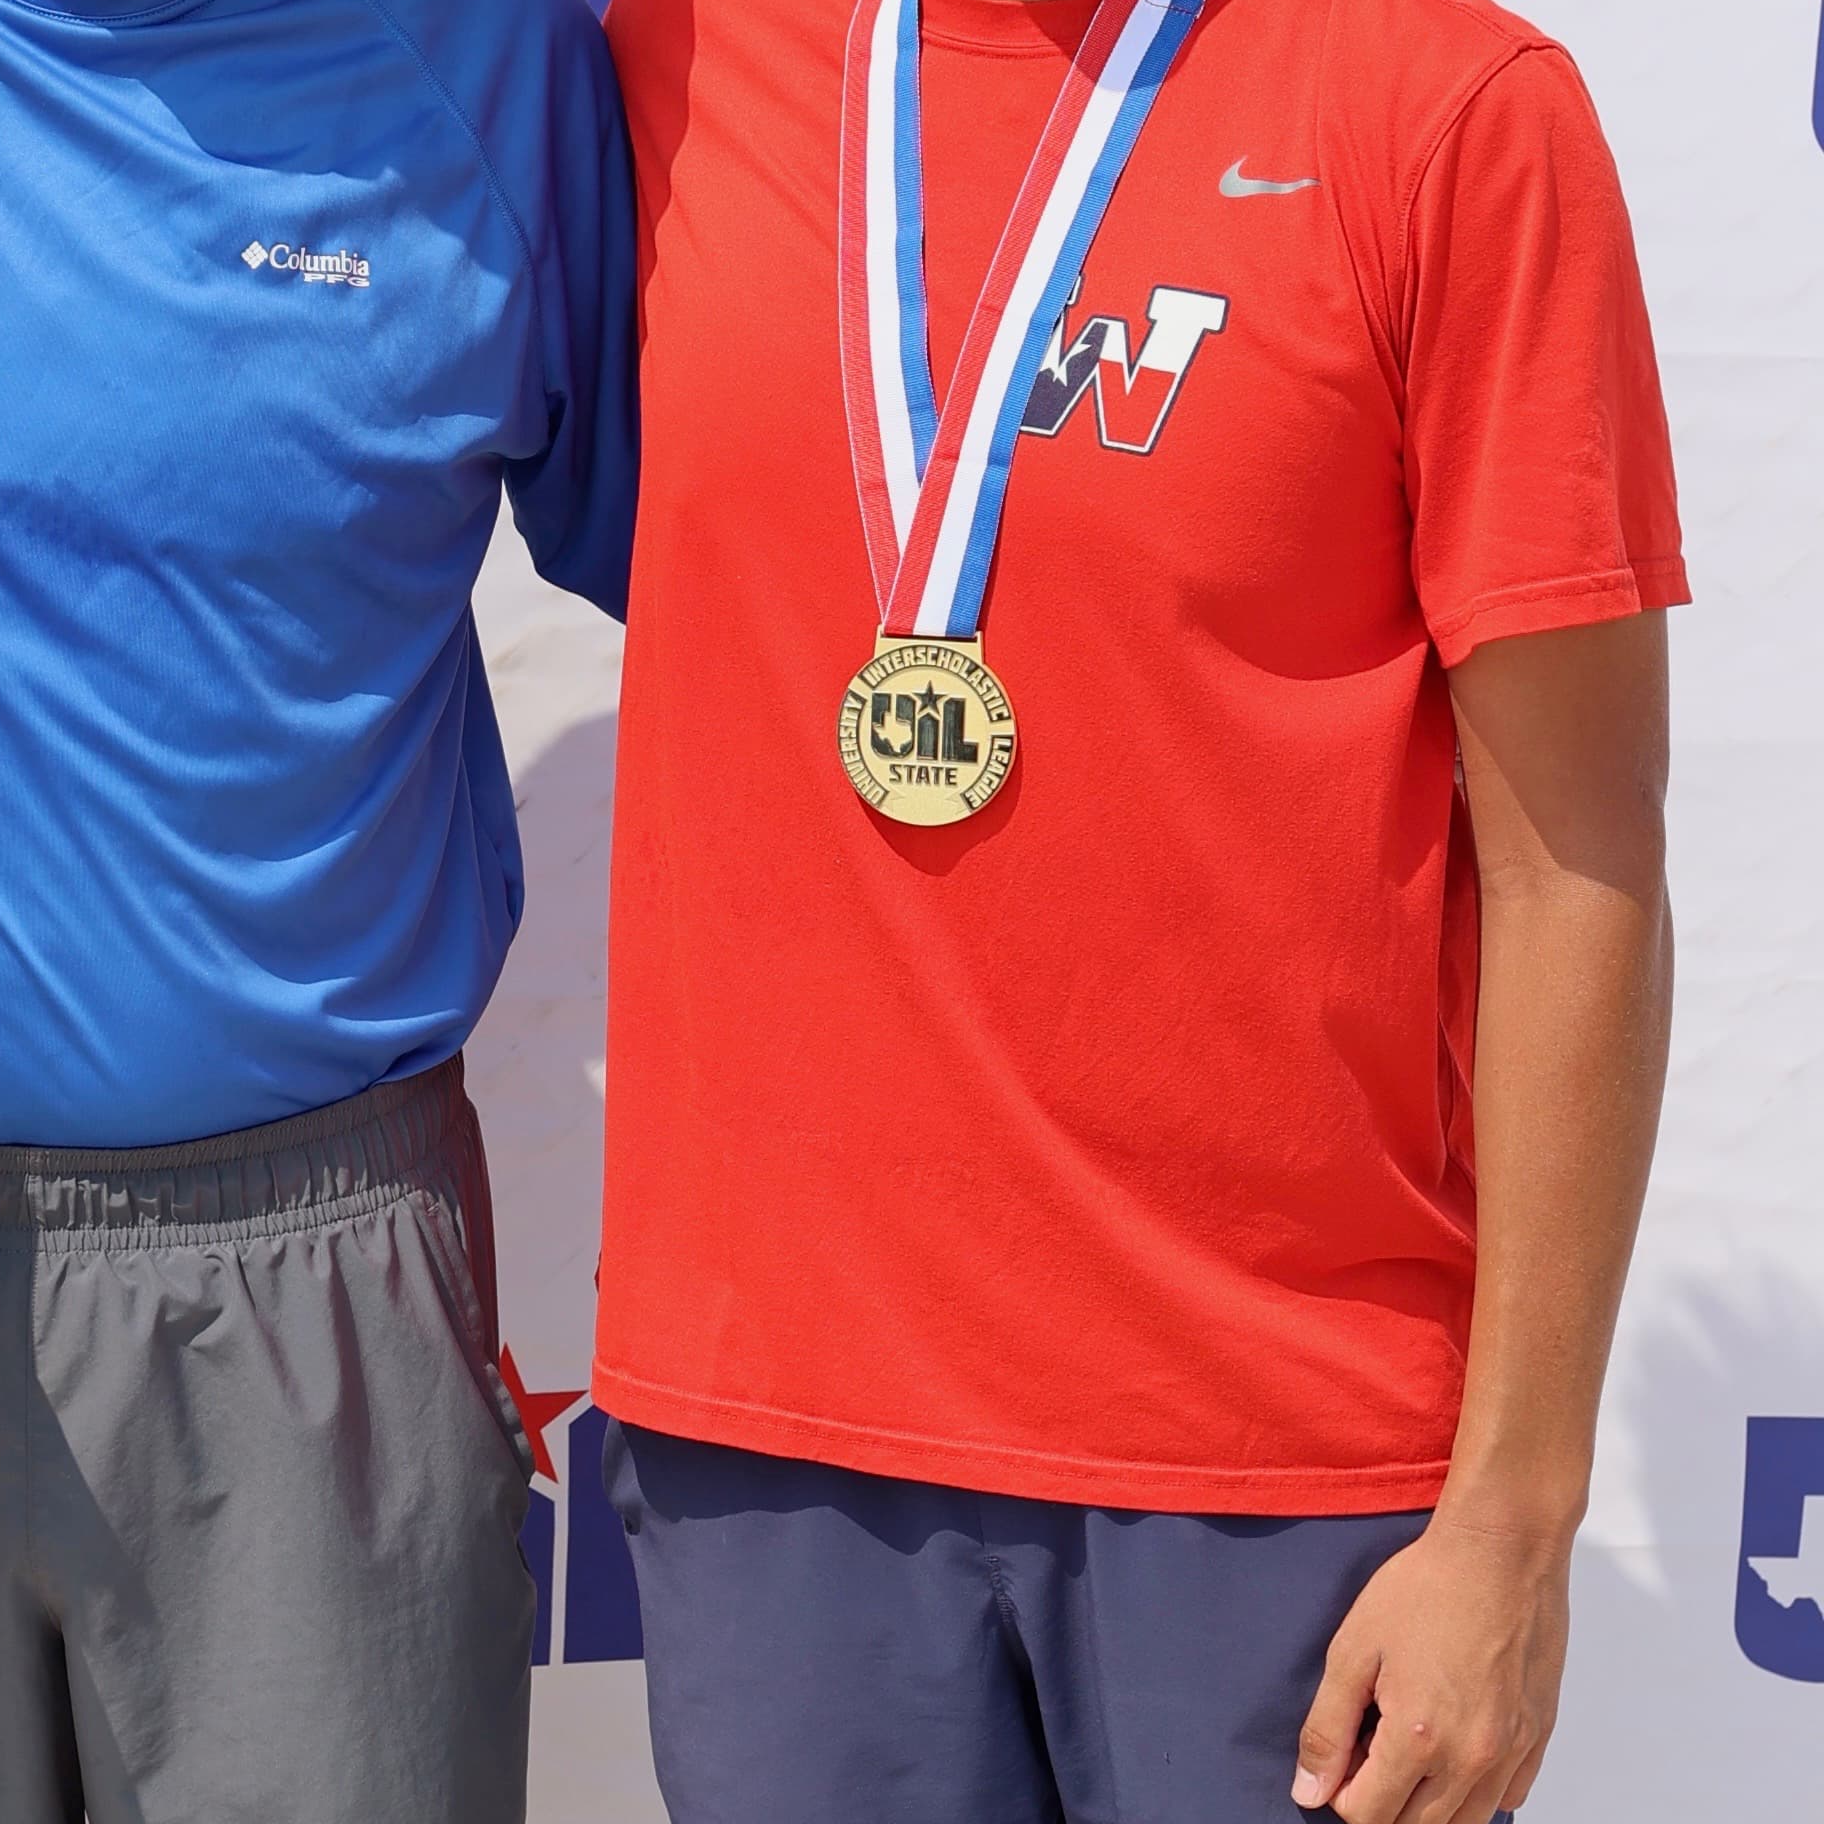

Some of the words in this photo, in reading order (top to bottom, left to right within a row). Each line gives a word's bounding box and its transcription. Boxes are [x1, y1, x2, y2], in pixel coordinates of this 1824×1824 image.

[269, 243, 370, 276] Columbia
[303, 272, 370, 288] PFG
[861, 646, 1010, 721] INTERSCHOLASTIC
[839, 694, 886, 805] UNIVERSITY
[870, 692, 979, 763] UIL
[888, 764, 959, 786] STATE
[964, 737, 1012, 808] LEAGUE
